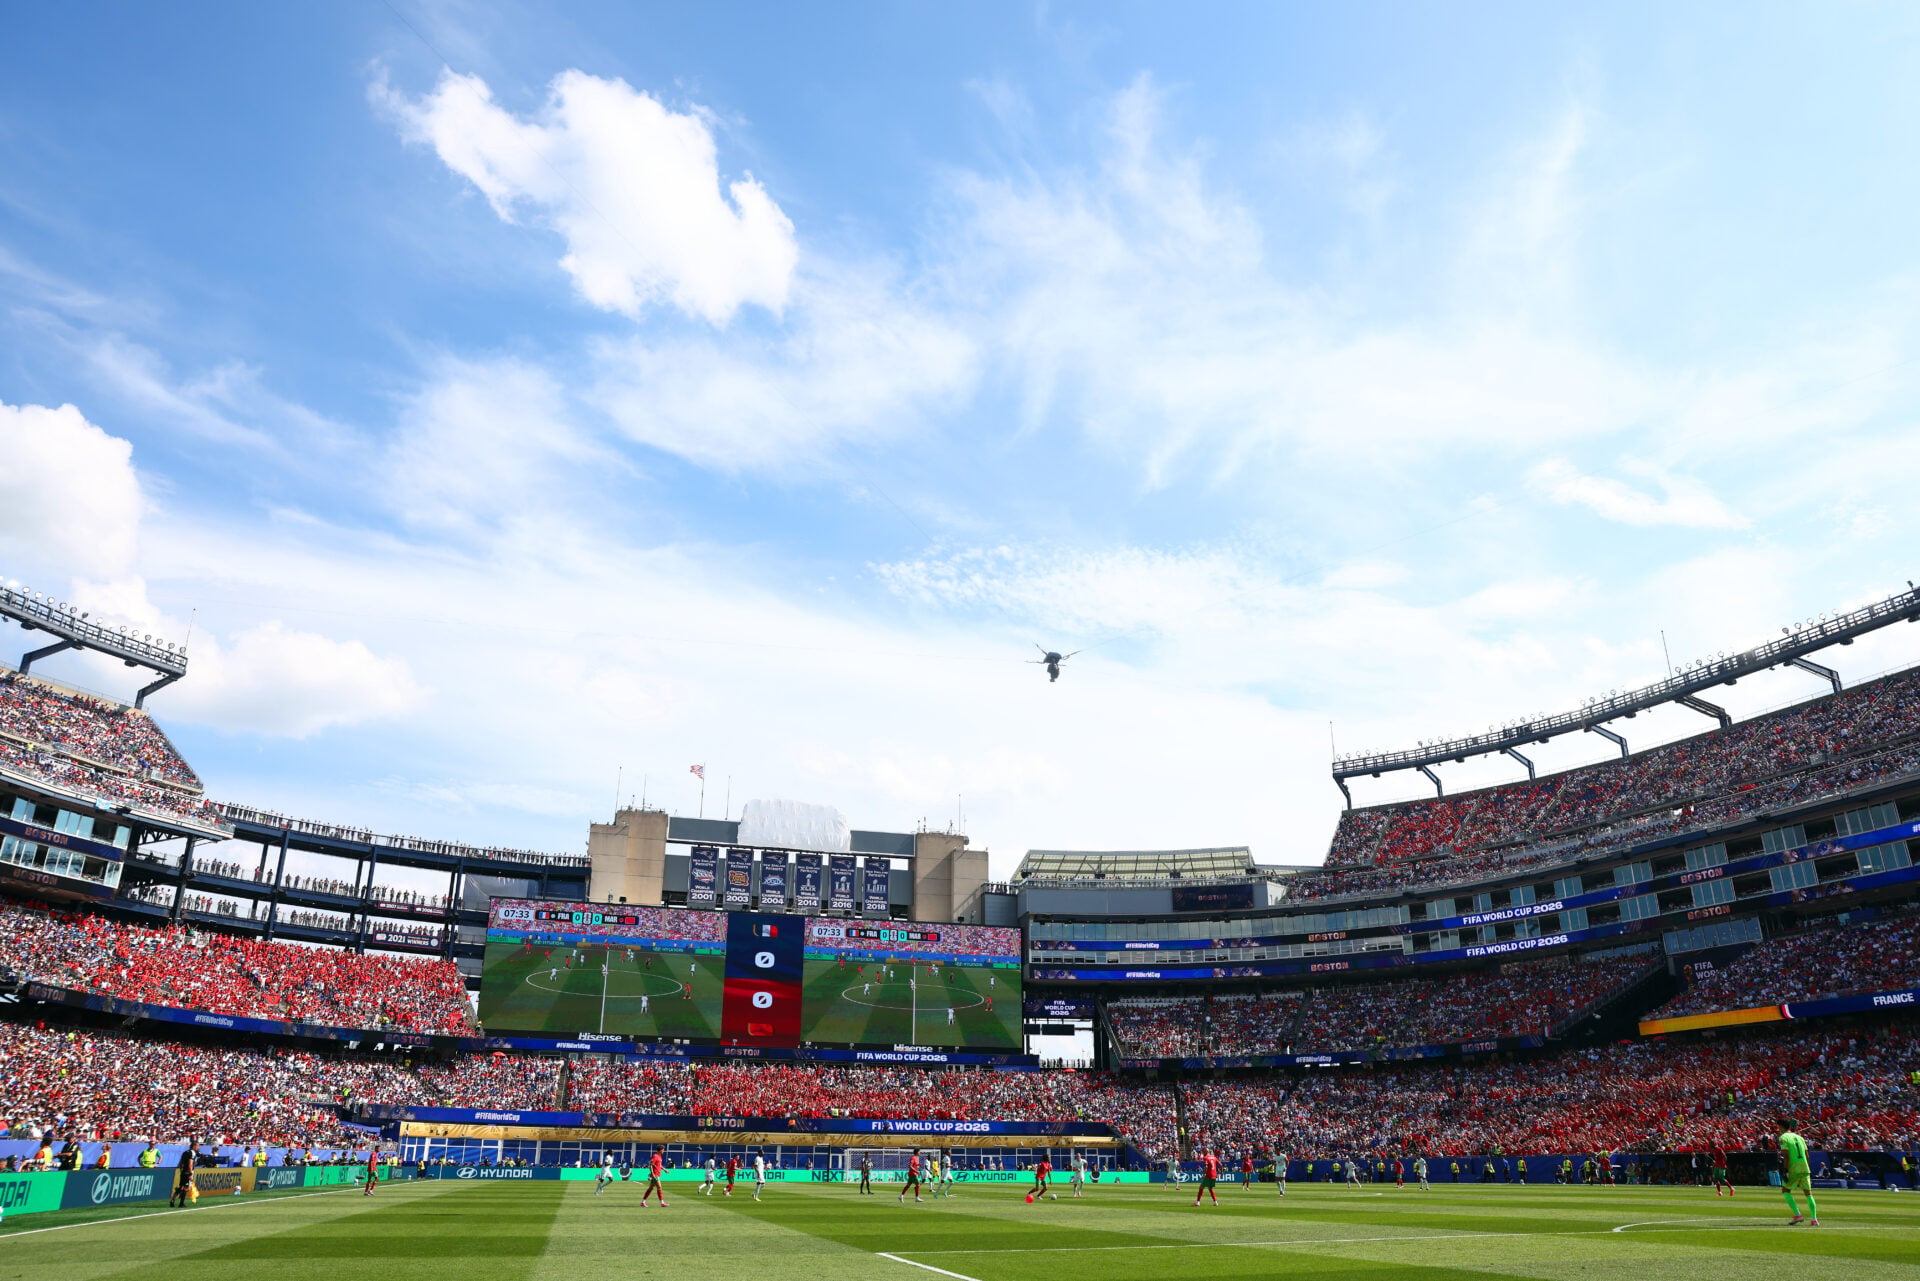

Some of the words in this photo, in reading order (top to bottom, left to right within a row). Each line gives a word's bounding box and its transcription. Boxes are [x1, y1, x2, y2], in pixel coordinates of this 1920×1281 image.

[24, 827, 68, 846] BOSTON
[12, 868, 58, 886] BOSTON
[1680, 868, 1723, 884] BOSTON
[504, 910, 530, 918] 07:33
[1463, 916, 1482, 925] FIFA
[1482, 910, 1513, 922] WORLD
[1514, 907, 1532, 916] CUP
[1533, 902, 1563, 913] 2026
[1687, 904, 1730, 920] BOSTON
[817, 928, 840, 936] 07:33
[1308, 932, 1347, 942] BOSTON
[388, 935, 405, 943] 2021
[1467, 947, 1485, 956] FIFA
[1486, 943, 1517, 953] WORLD
[1519, 940, 1536, 949] CUP
[1537, 935, 1568, 947] 2026
[755, 952, 775, 968] 0
[1310, 962, 1348, 972] BOSTON
[1694, 962, 1713, 970] FIFA
[28, 983, 66, 1001] BOSTON
[752, 992, 773, 1008] 0
[1873, 992, 1914, 1006] FRANCE
[195, 1014, 234, 1027] #FIFAWorldCup
[385, 1034, 430, 1045] BOSTON
[578, 1032, 622, 1041] Hisense
[724, 1048, 760, 1056] BOSTON
[894, 1044, 933, 1052] Hisense
[1462, 1041, 1497, 1052] BOSTON
[856, 1052, 874, 1060] FIFA
[1121, 1059, 1160, 1068] BOSTON
[475, 1112, 520, 1122] #FIFAWorldCup
[698, 1118, 745, 1128] BSTON
[871, 1121, 894, 1130] FIA
[895, 1121, 932, 1130] WORLD
[933, 1122, 954, 1130] CUP
[955, 1123, 990, 1131] 2026
[276, 1170, 296, 1185] HYUNDAI
[480, 1169, 533, 1178] HYUNDAI
[812, 1171, 845, 1182] NEXT
[973, 1173, 1017, 1181] HYUNDAI
[111, 1175, 154, 1198] HYUNDAI
[196, 1172, 242, 1191] MASSACHUSETTS
